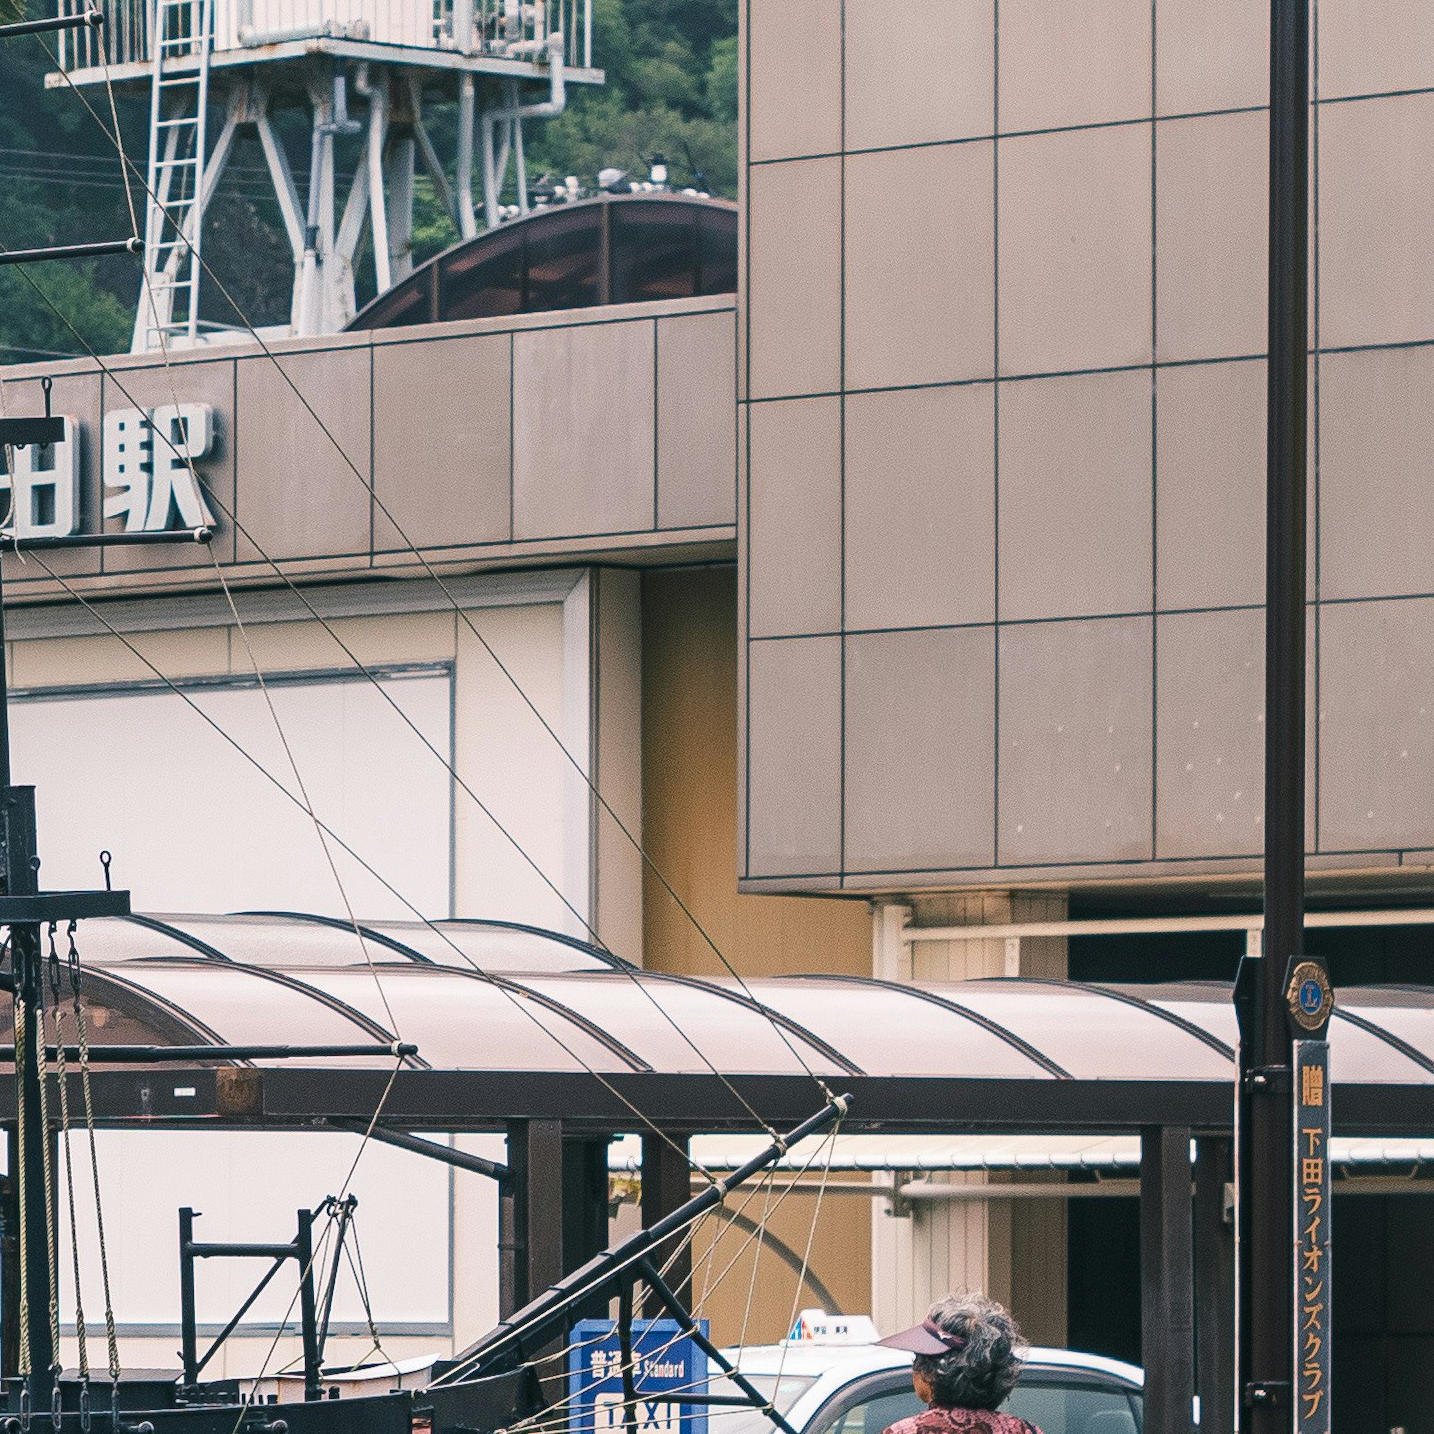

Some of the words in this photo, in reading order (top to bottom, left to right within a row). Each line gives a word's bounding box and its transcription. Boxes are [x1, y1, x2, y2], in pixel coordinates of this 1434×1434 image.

[1302, 1065, 1323, 1106] 贈
[1302, 1127, 1323, 1420] 下田ライオンズクラブ
